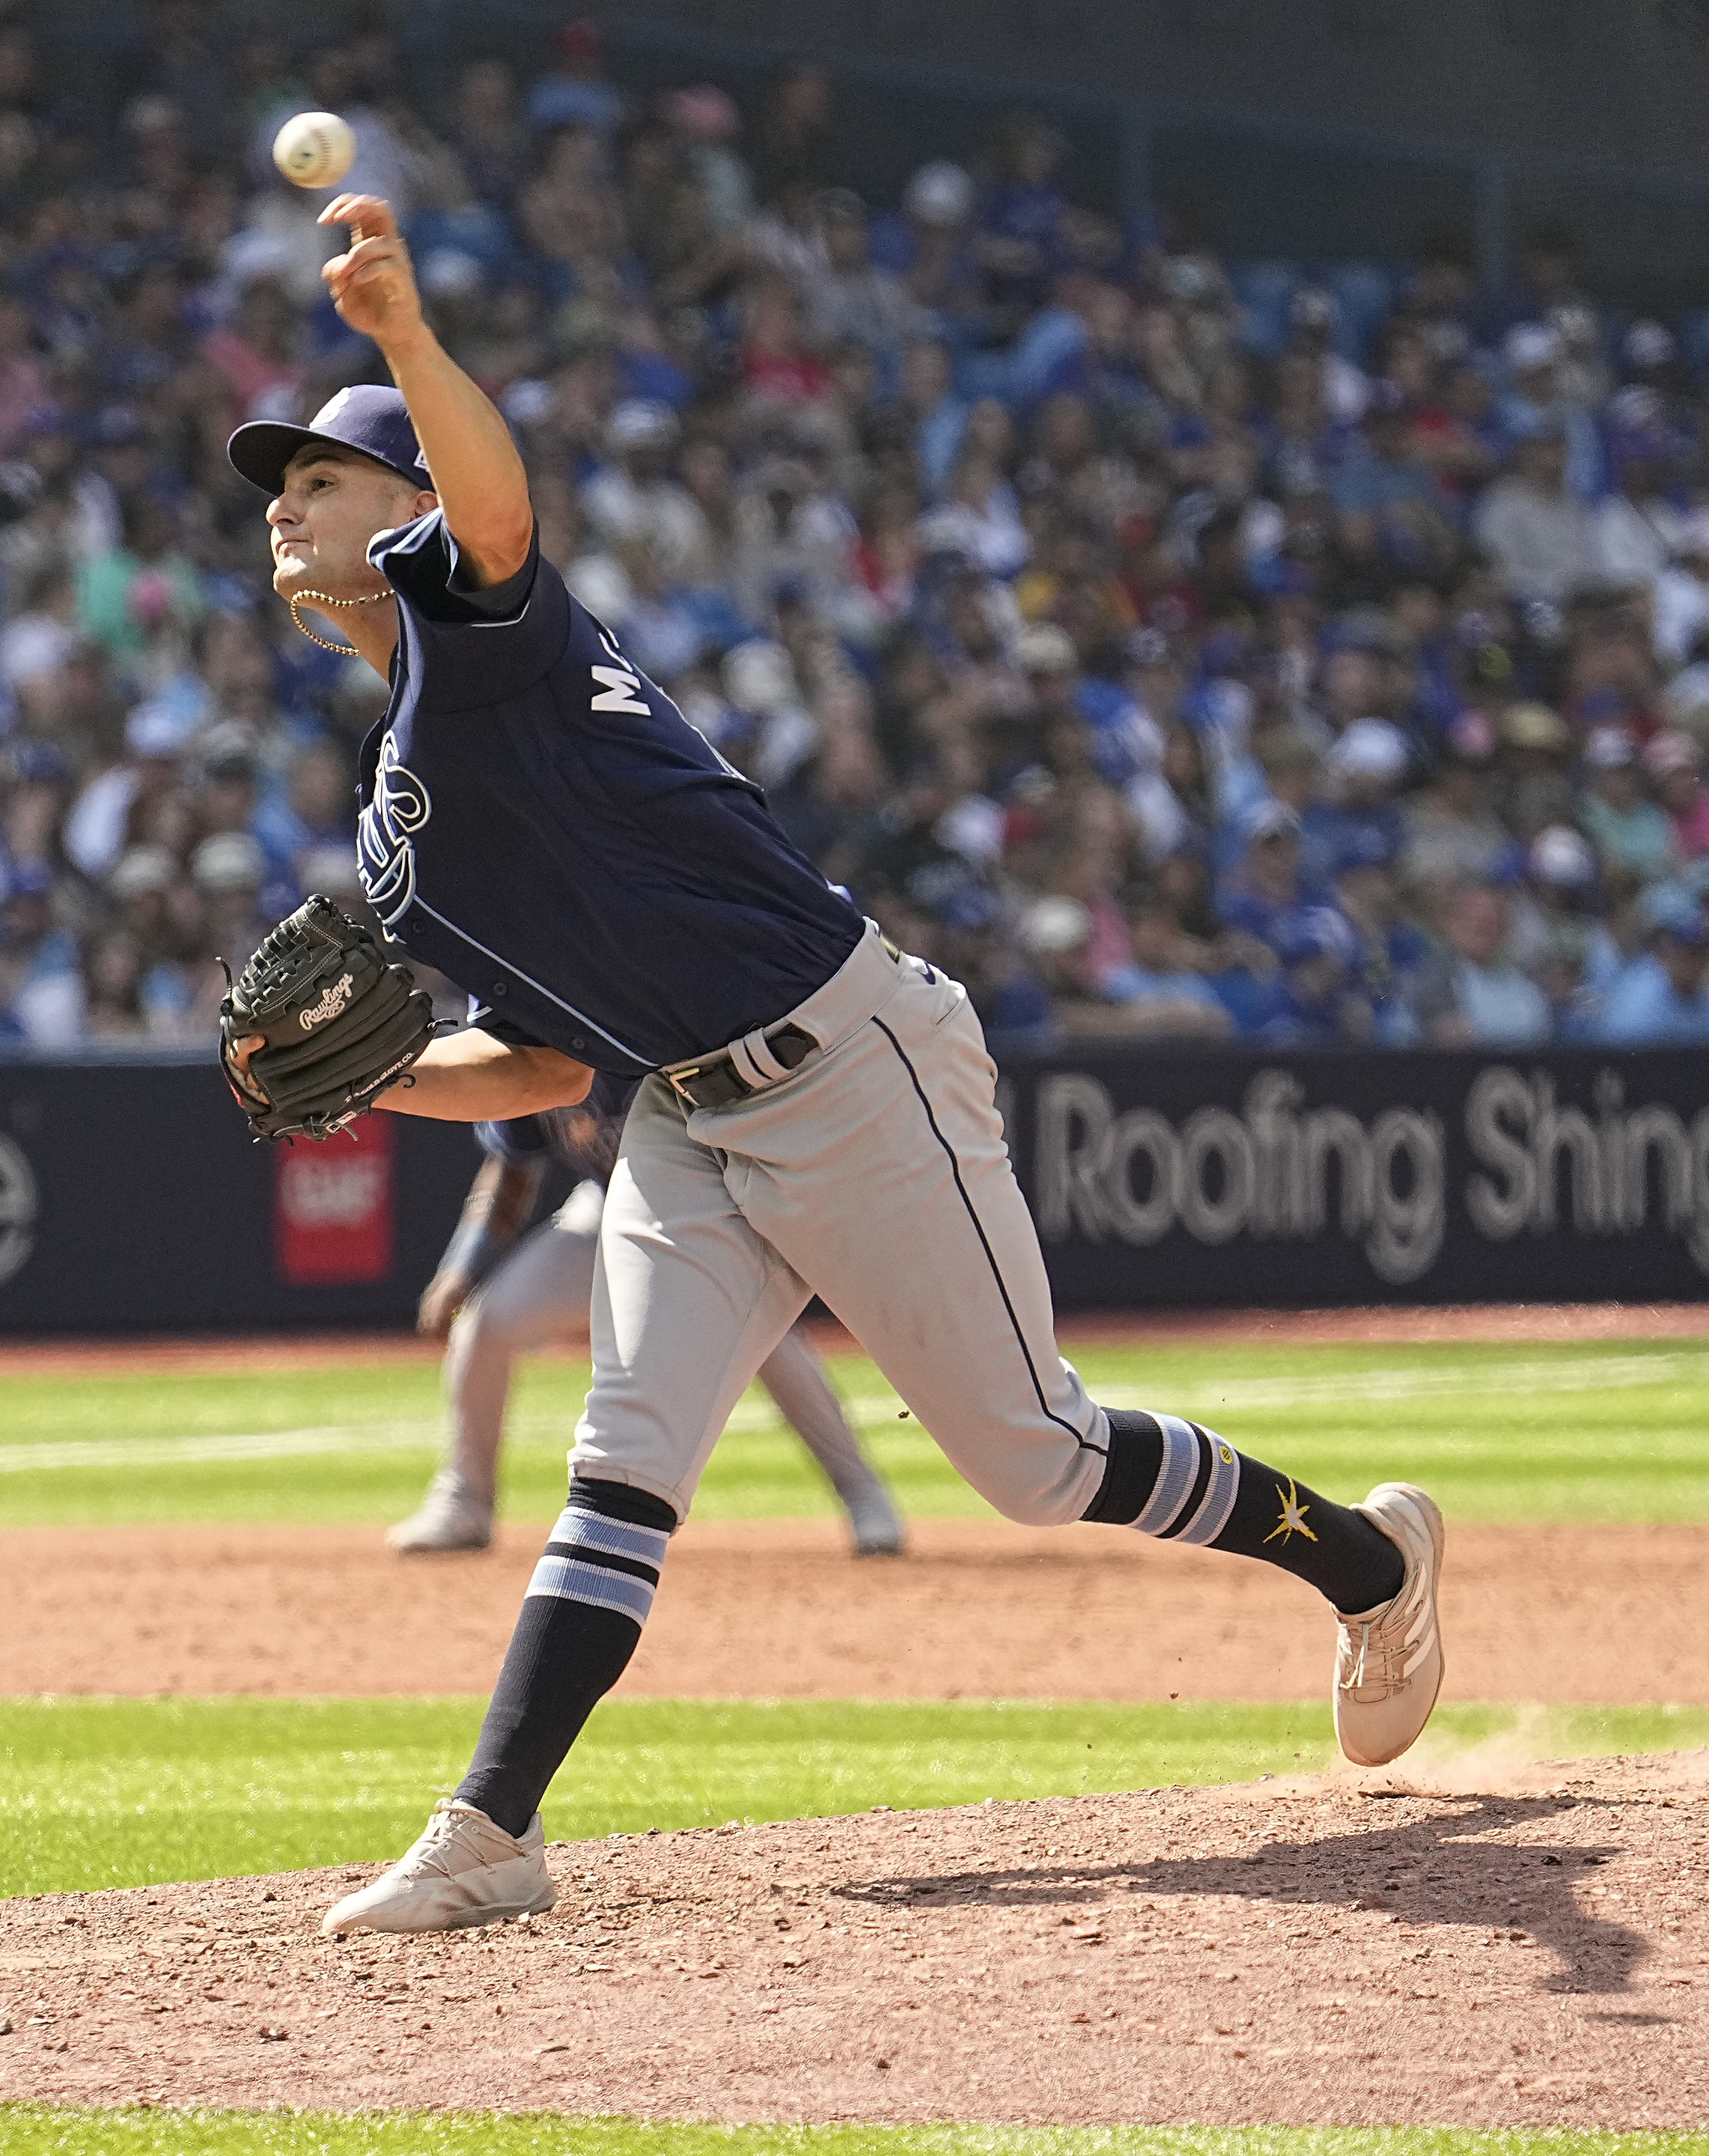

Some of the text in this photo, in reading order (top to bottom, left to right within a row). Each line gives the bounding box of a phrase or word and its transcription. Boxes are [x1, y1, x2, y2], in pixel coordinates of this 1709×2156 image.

[299, 972, 354, 1031] Rawlings
[380, 1061, 403, 1080] GLOVE
[1037, 1071, 1444, 1281] Roofing
[1464, 1066, 1709, 1276] Shin
